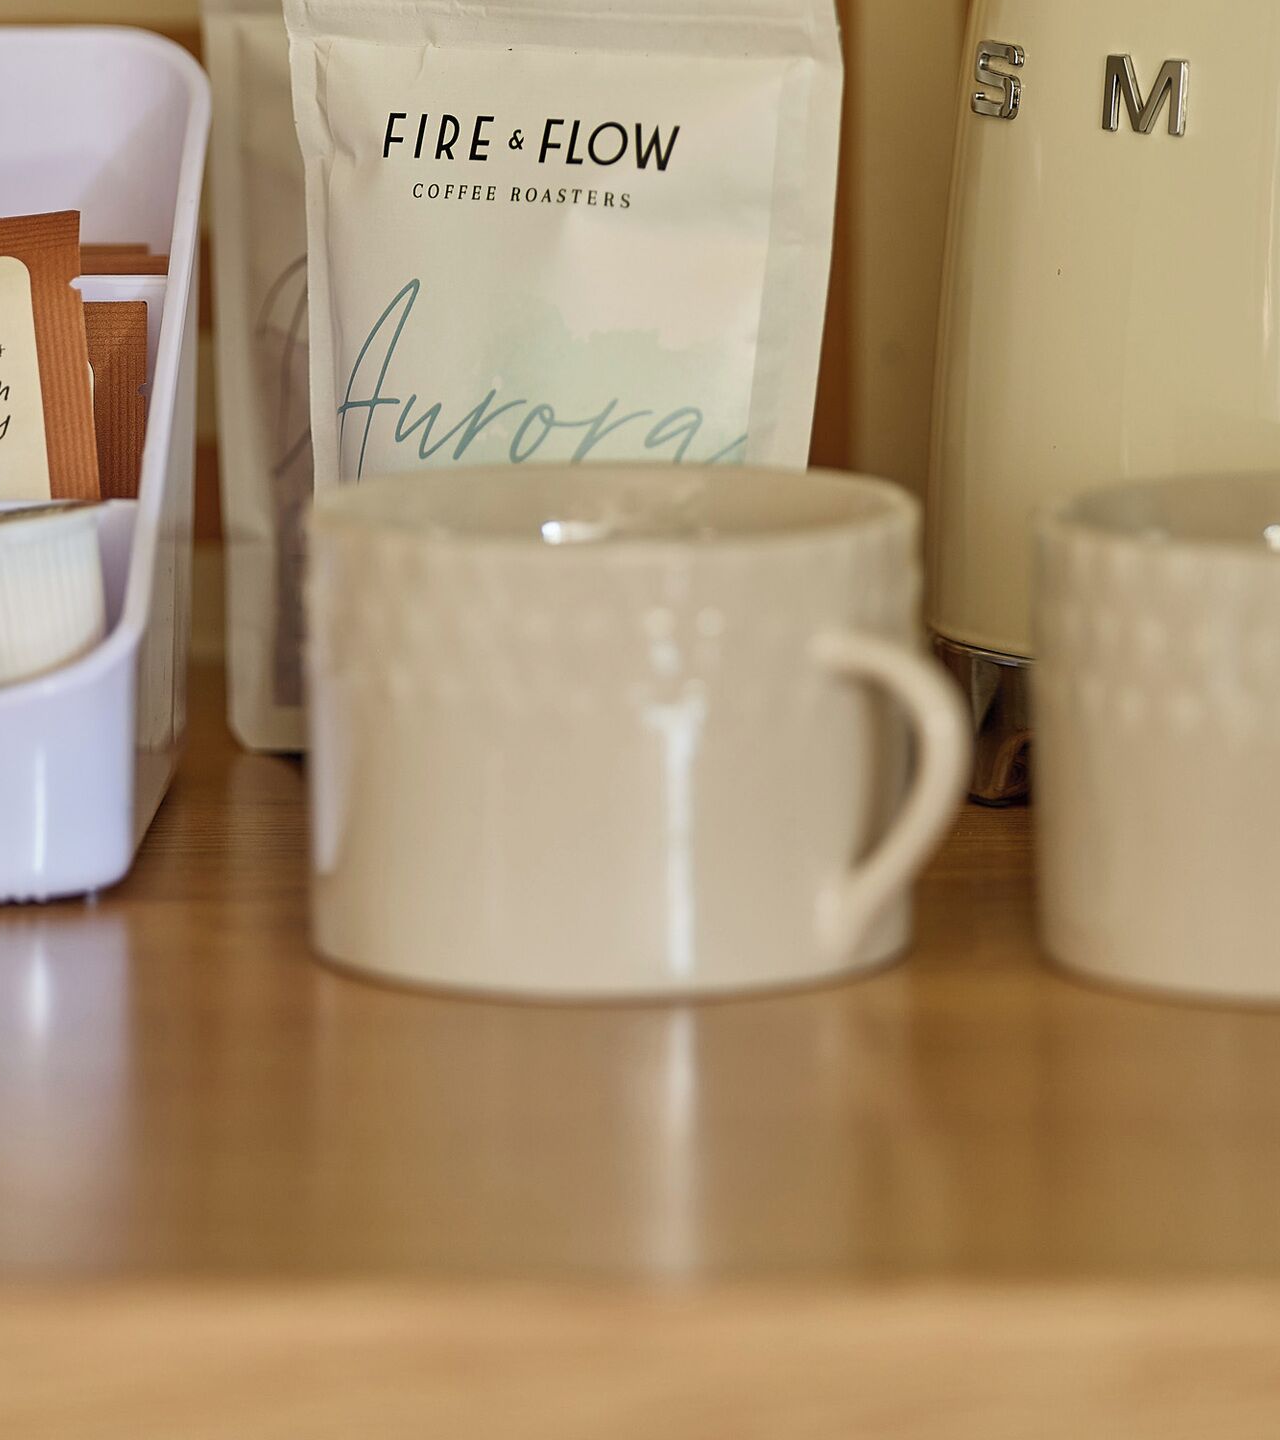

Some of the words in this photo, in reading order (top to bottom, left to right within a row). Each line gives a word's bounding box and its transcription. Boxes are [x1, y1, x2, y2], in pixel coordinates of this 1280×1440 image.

[382, 112, 496, 161] FIRE
[507, 128, 526, 151] &
[537, 117, 681, 172] FLOW
[411, 182, 498, 202] COFFEE
[509, 185, 632, 210] ROASTERS
[337, 277, 748, 486] Aurora
